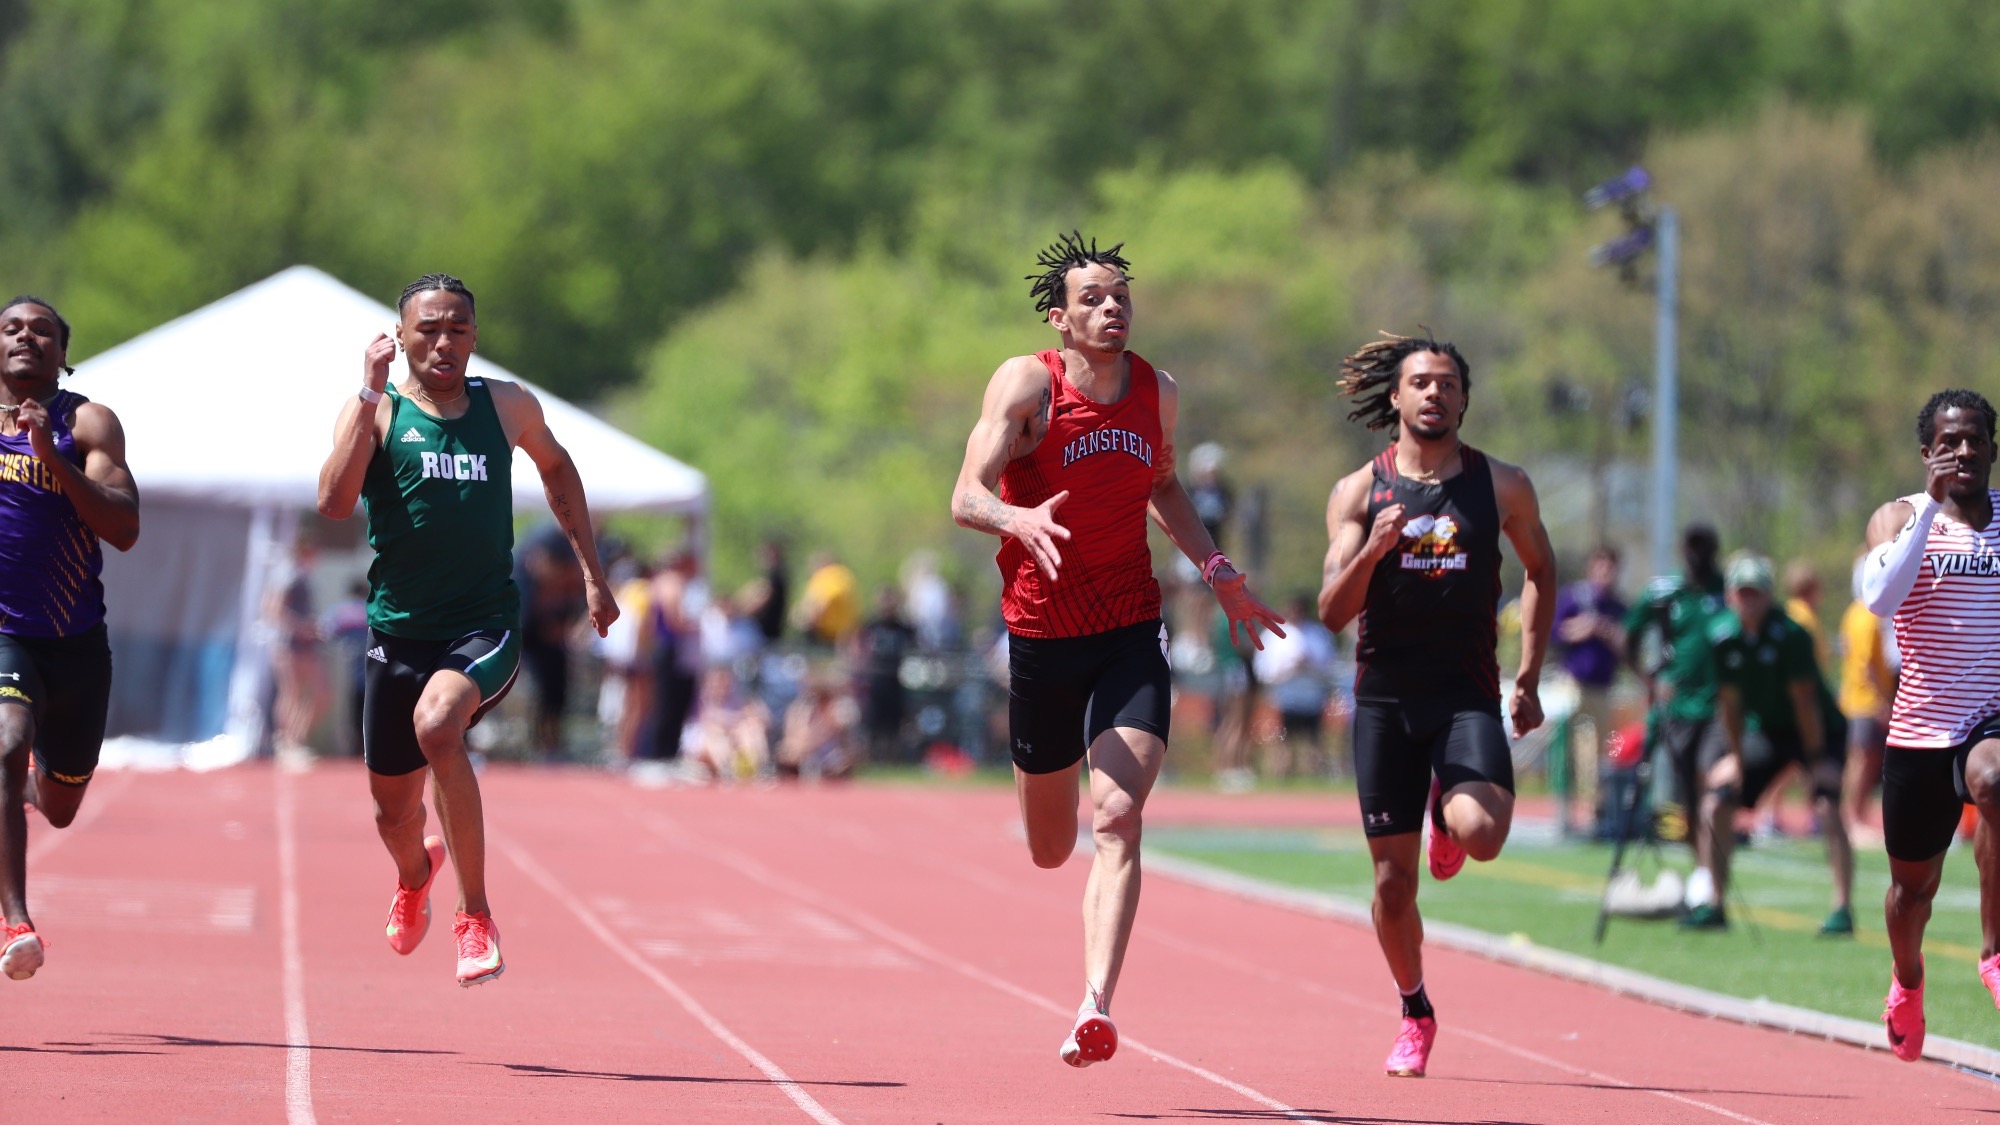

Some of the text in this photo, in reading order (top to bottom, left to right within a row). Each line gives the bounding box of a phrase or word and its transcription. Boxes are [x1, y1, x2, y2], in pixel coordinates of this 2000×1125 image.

[1062, 428, 1152, 468] MANSFIELD
[420, 451, 488, 482] ROCK
[367, 651, 388, 664] adidas
